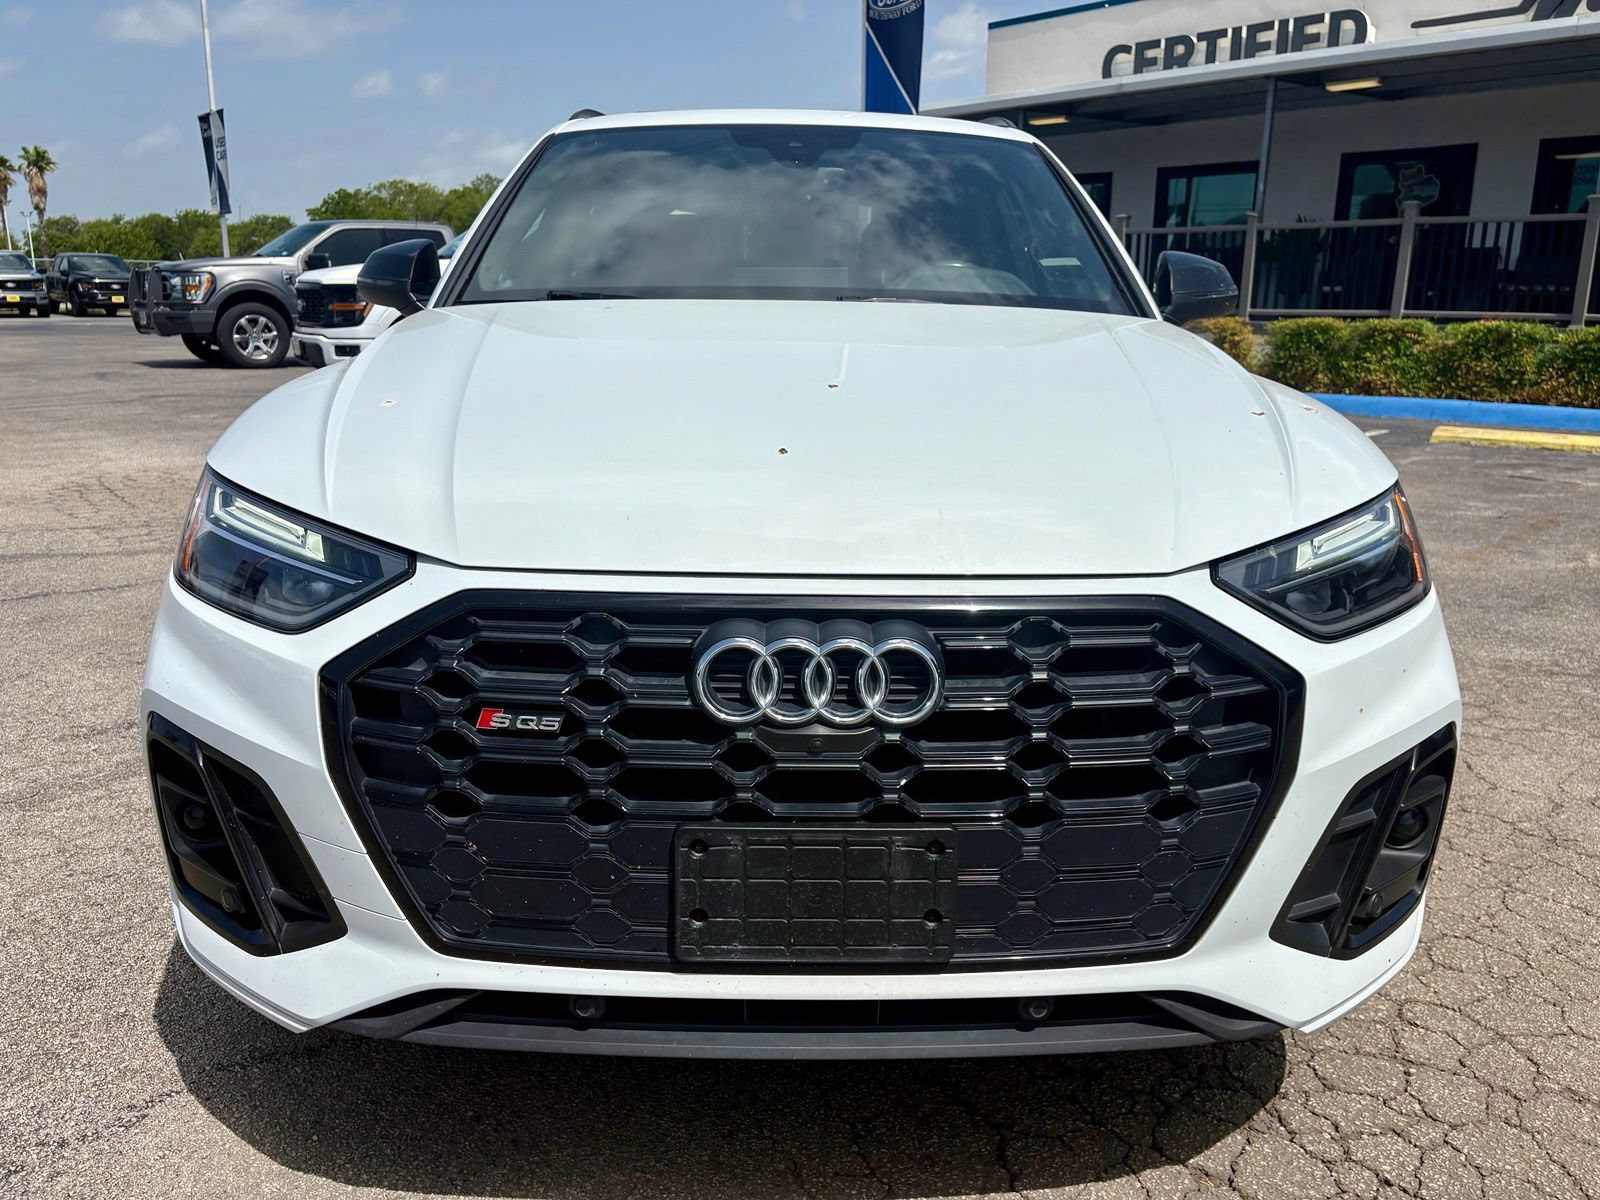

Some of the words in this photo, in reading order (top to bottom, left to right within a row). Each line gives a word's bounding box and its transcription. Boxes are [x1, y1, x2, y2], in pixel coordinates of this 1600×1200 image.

[902, 0, 922, 16] FORD
[1101, 9, 1369, 79] CERTIFIED
[489, 713, 561, 730] SQ5
